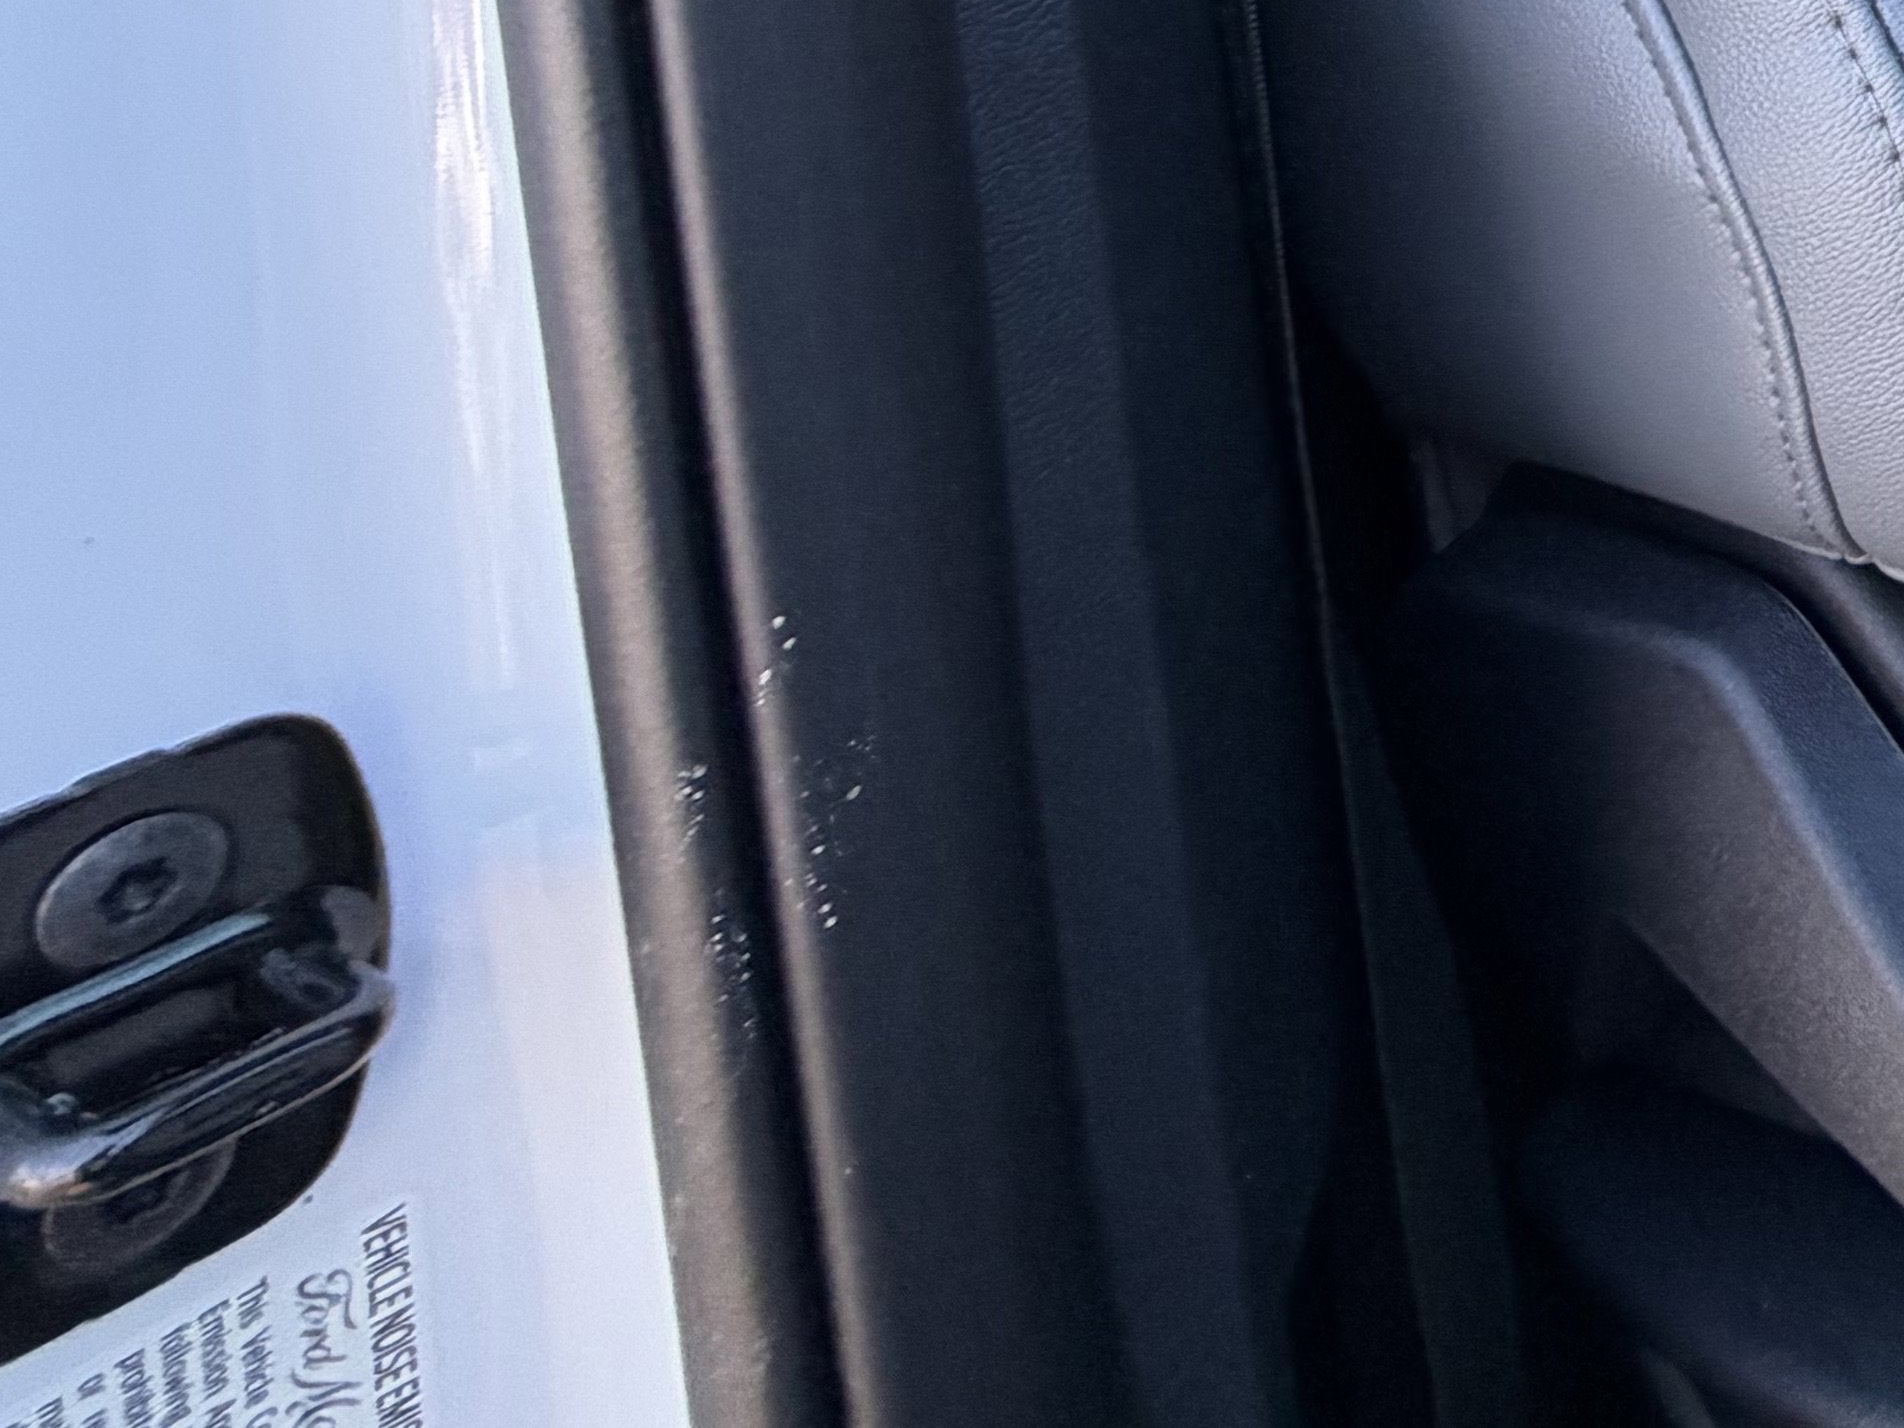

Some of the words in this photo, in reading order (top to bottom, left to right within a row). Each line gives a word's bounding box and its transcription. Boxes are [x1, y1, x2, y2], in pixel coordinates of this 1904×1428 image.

[236, 1275, 270, 1330] This
[361, 1202, 413, 1319] VEHICLE
[198, 1297, 234, 1403] Emission
[240, 1324, 275, 1410] Vehicle
[295, 1268, 358, 1370] Ford
[369, 1302, 418, 1392] NOISE
